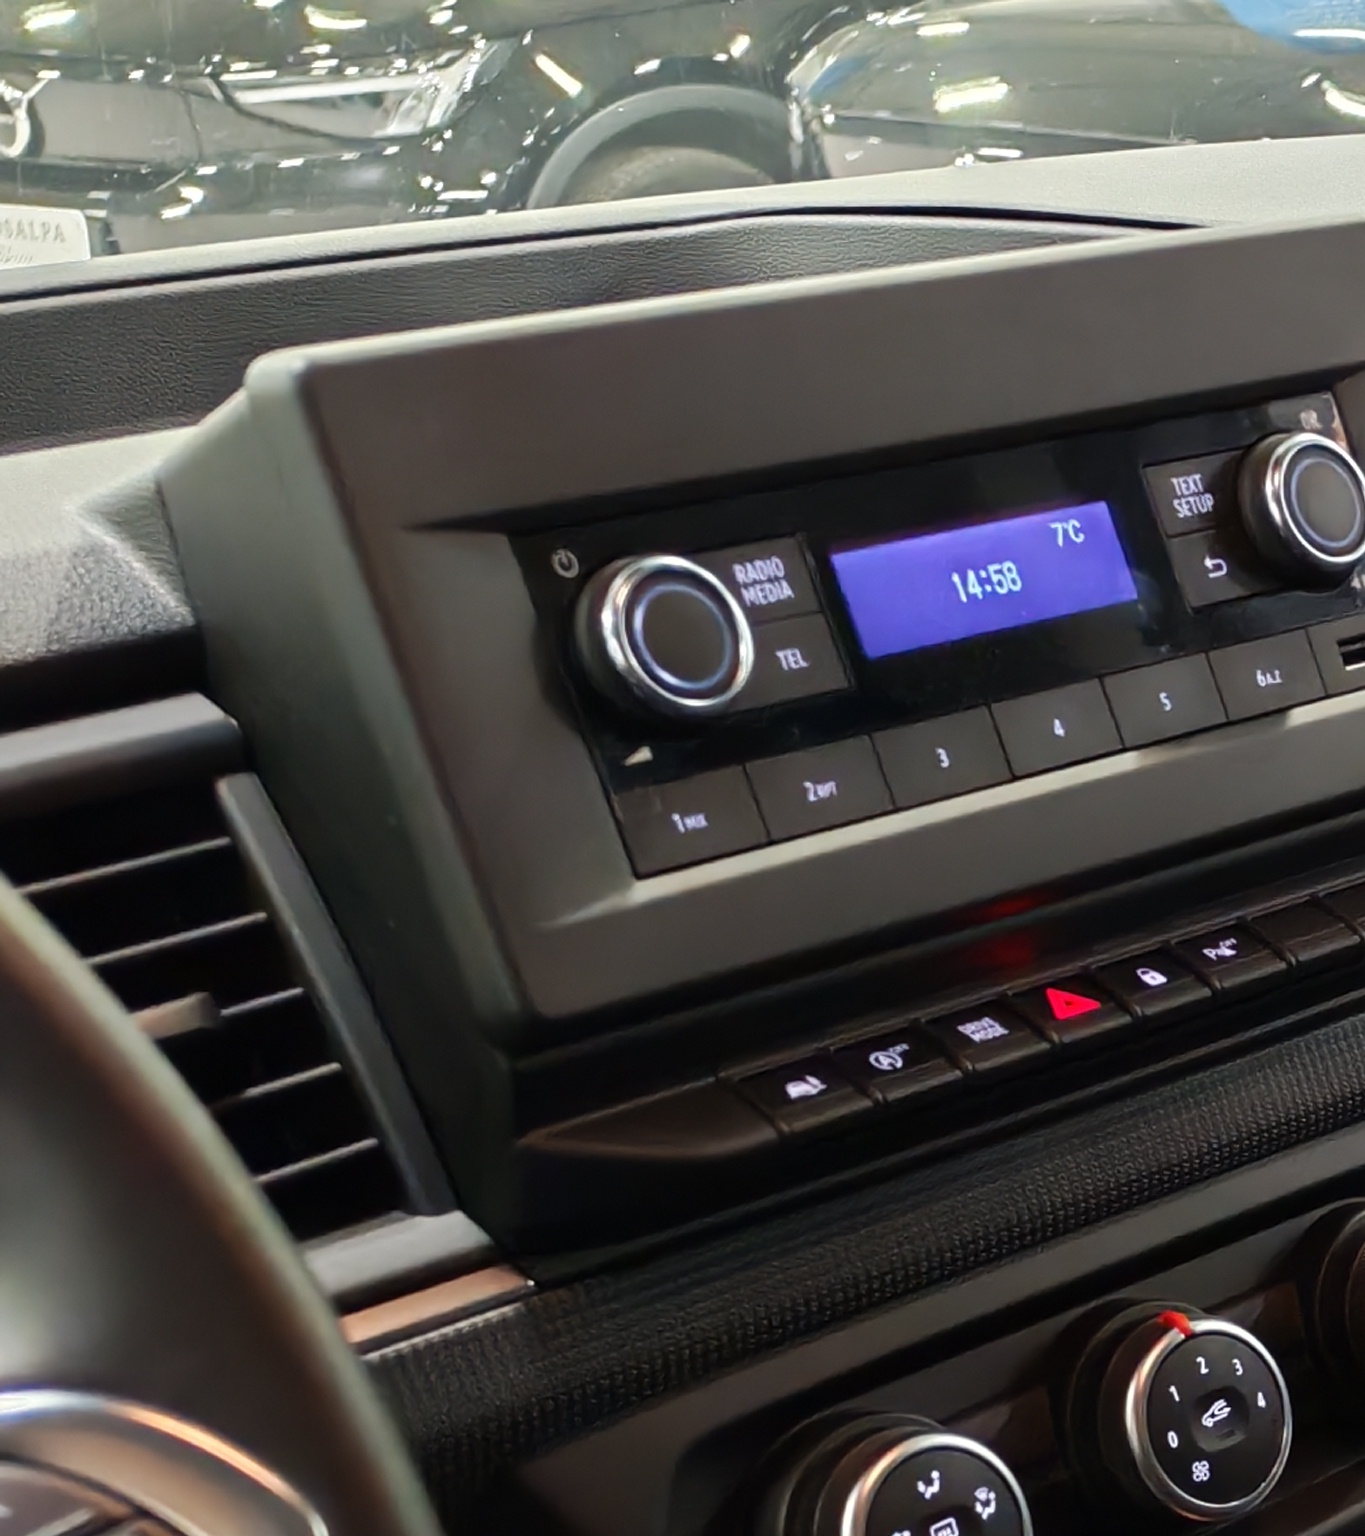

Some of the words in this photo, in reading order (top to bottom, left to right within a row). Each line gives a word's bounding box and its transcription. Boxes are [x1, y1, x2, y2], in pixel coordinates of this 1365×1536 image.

[0, 218, 66, 243] SALPA
[1170, 473, 1204, 497] TEXT
[1173, 493, 1214, 518] SETUP
[732, 555, 785, 584] RADIO
[951, 560, 1022, 603] 14:58
[741, 579, 795, 607] MEDIA
[775, 648, 810, 671] TEL
[1159, 692, 1172, 711] 5
[1053, 718, 1065, 737] 4
[935, 747, 950, 768] 3
[1196, 1356, 1209, 1374] 2
[1232, 1358, 1243, 1375] 3
[1169, 1385, 1180, 1402] 1
[1257, 1391, 1266, 1408] 4
[1167, 1430, 1179, 1449] 0
